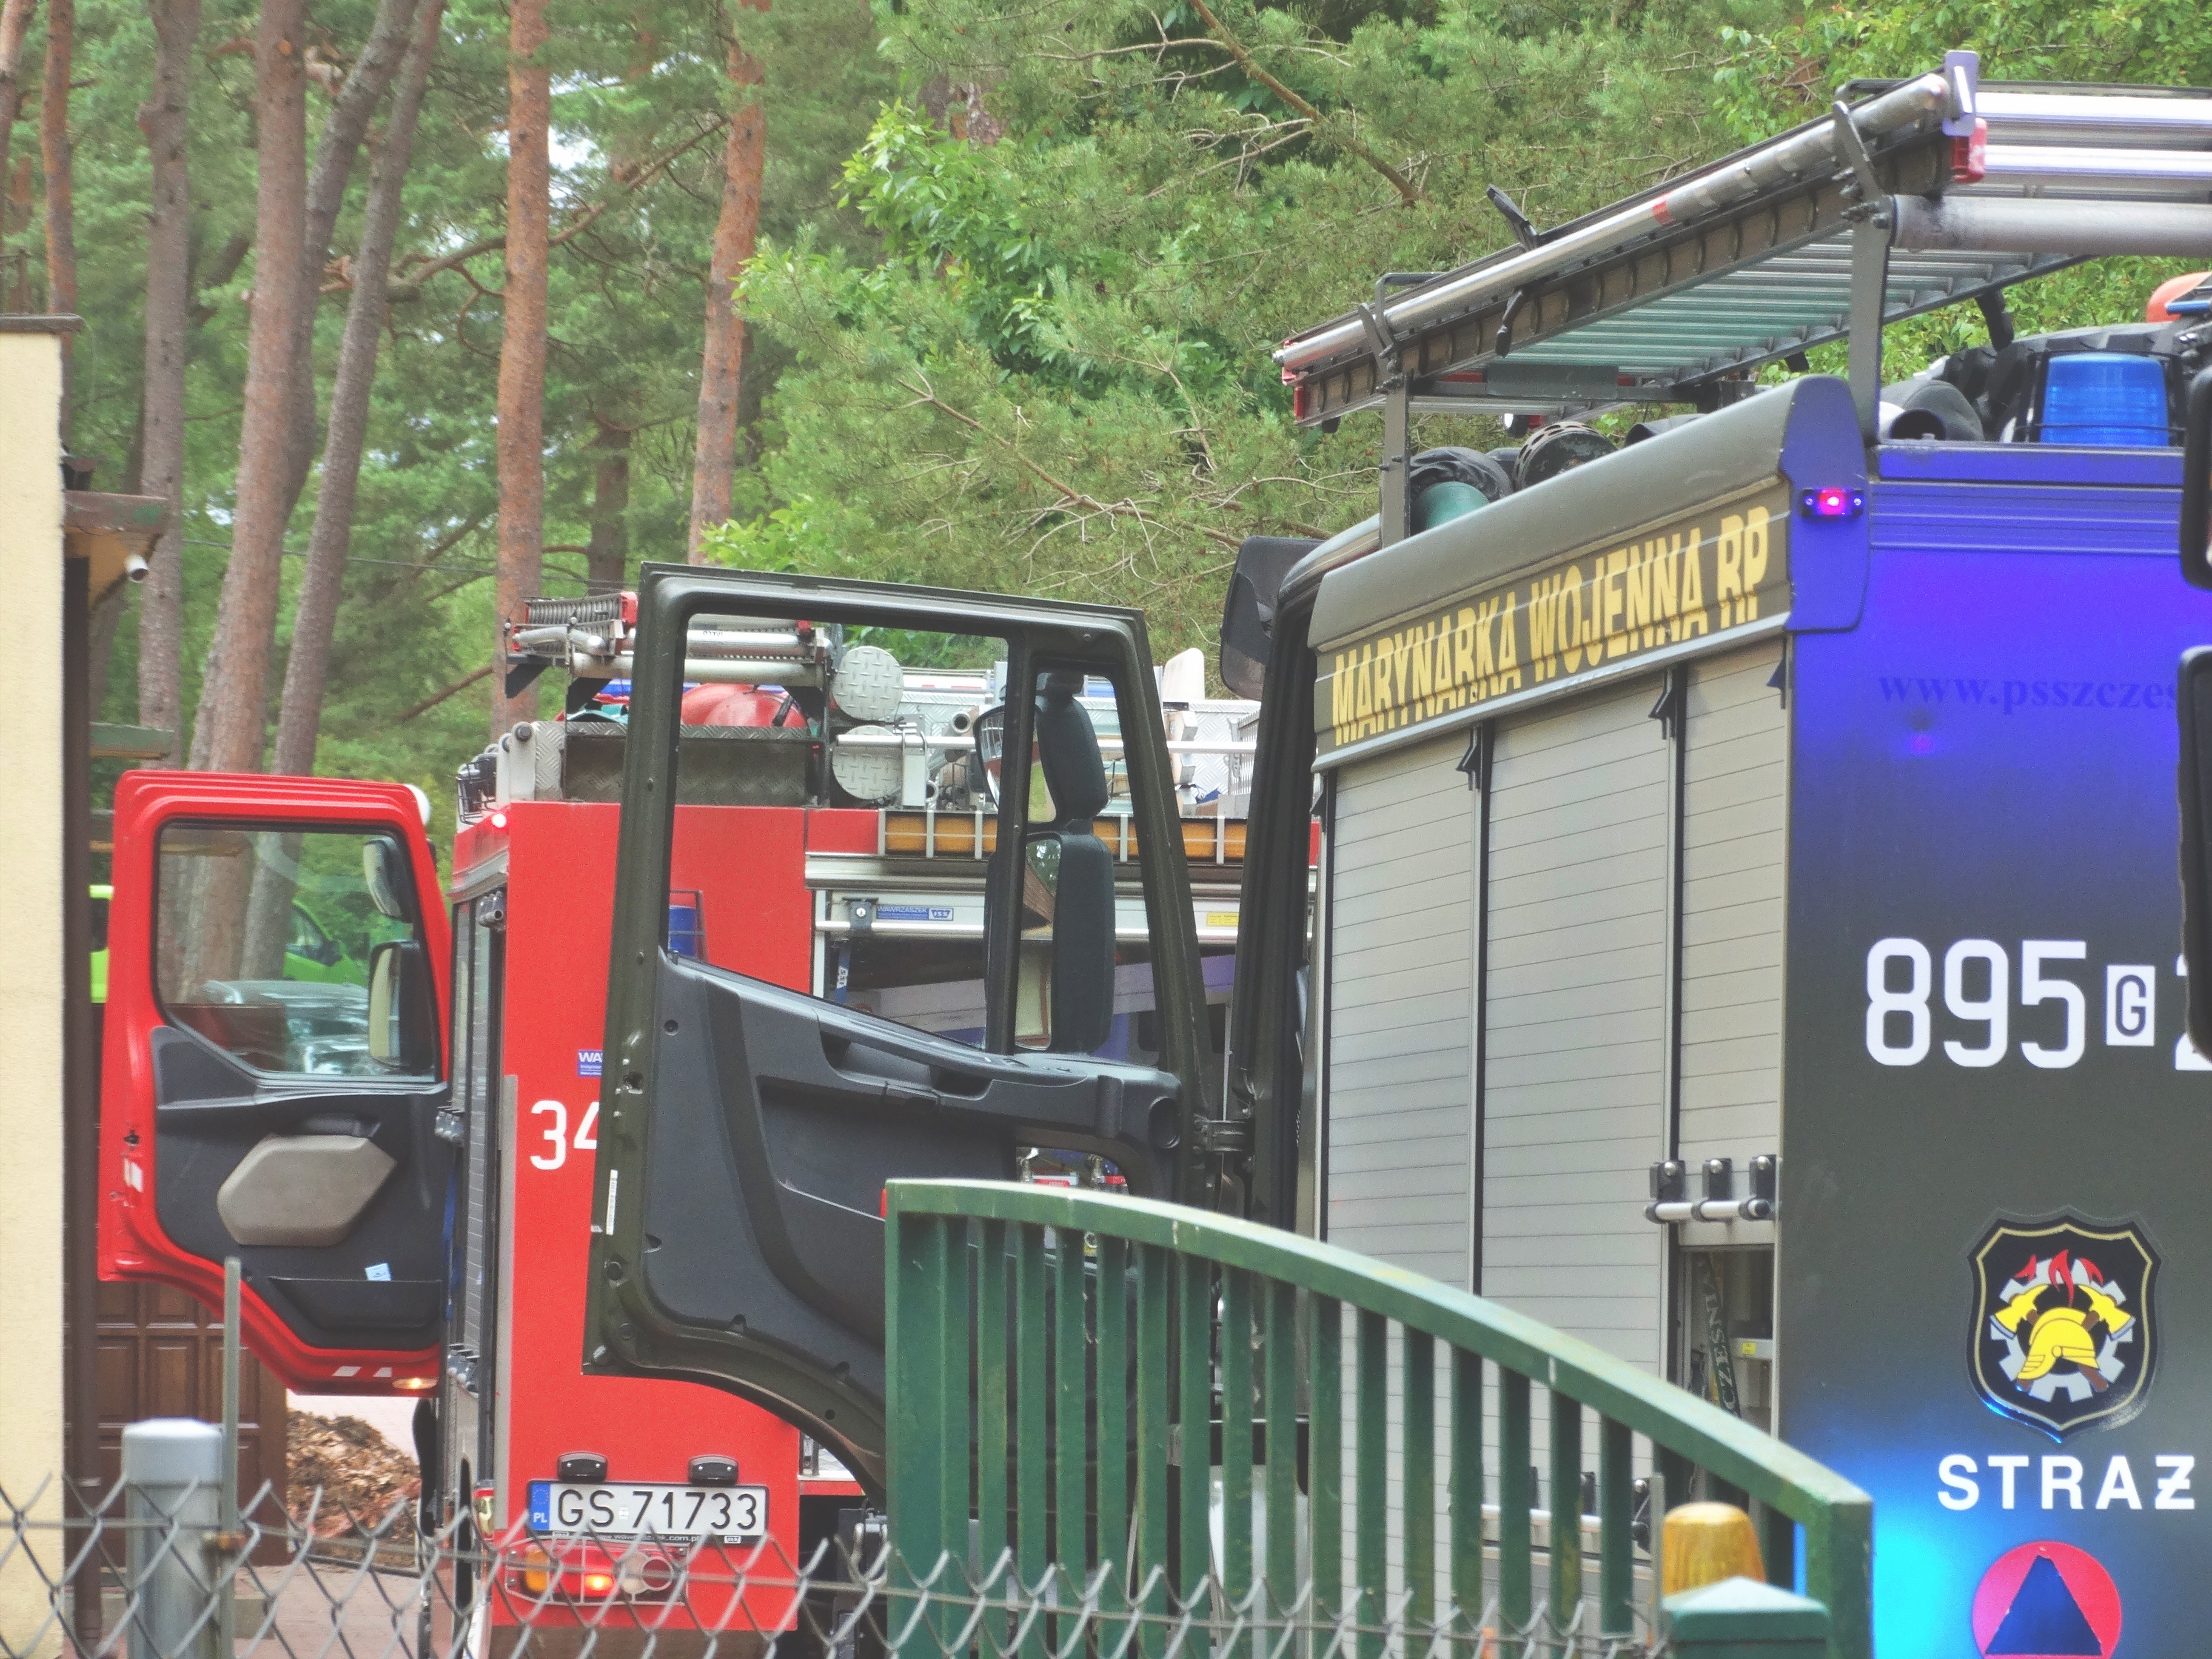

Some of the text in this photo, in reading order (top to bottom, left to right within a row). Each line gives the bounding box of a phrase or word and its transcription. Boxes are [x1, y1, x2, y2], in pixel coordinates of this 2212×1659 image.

[1333, 505, 1771, 747] MARYNARKA WOJENNA RP
[1866, 937, 2086, 1069] 895
[2113, 972, 2149, 1039] G
[578, 1052, 603, 1062] WA
[534, 1512, 548, 1523] PL
[558, 1489, 757, 1530] GS 71733
